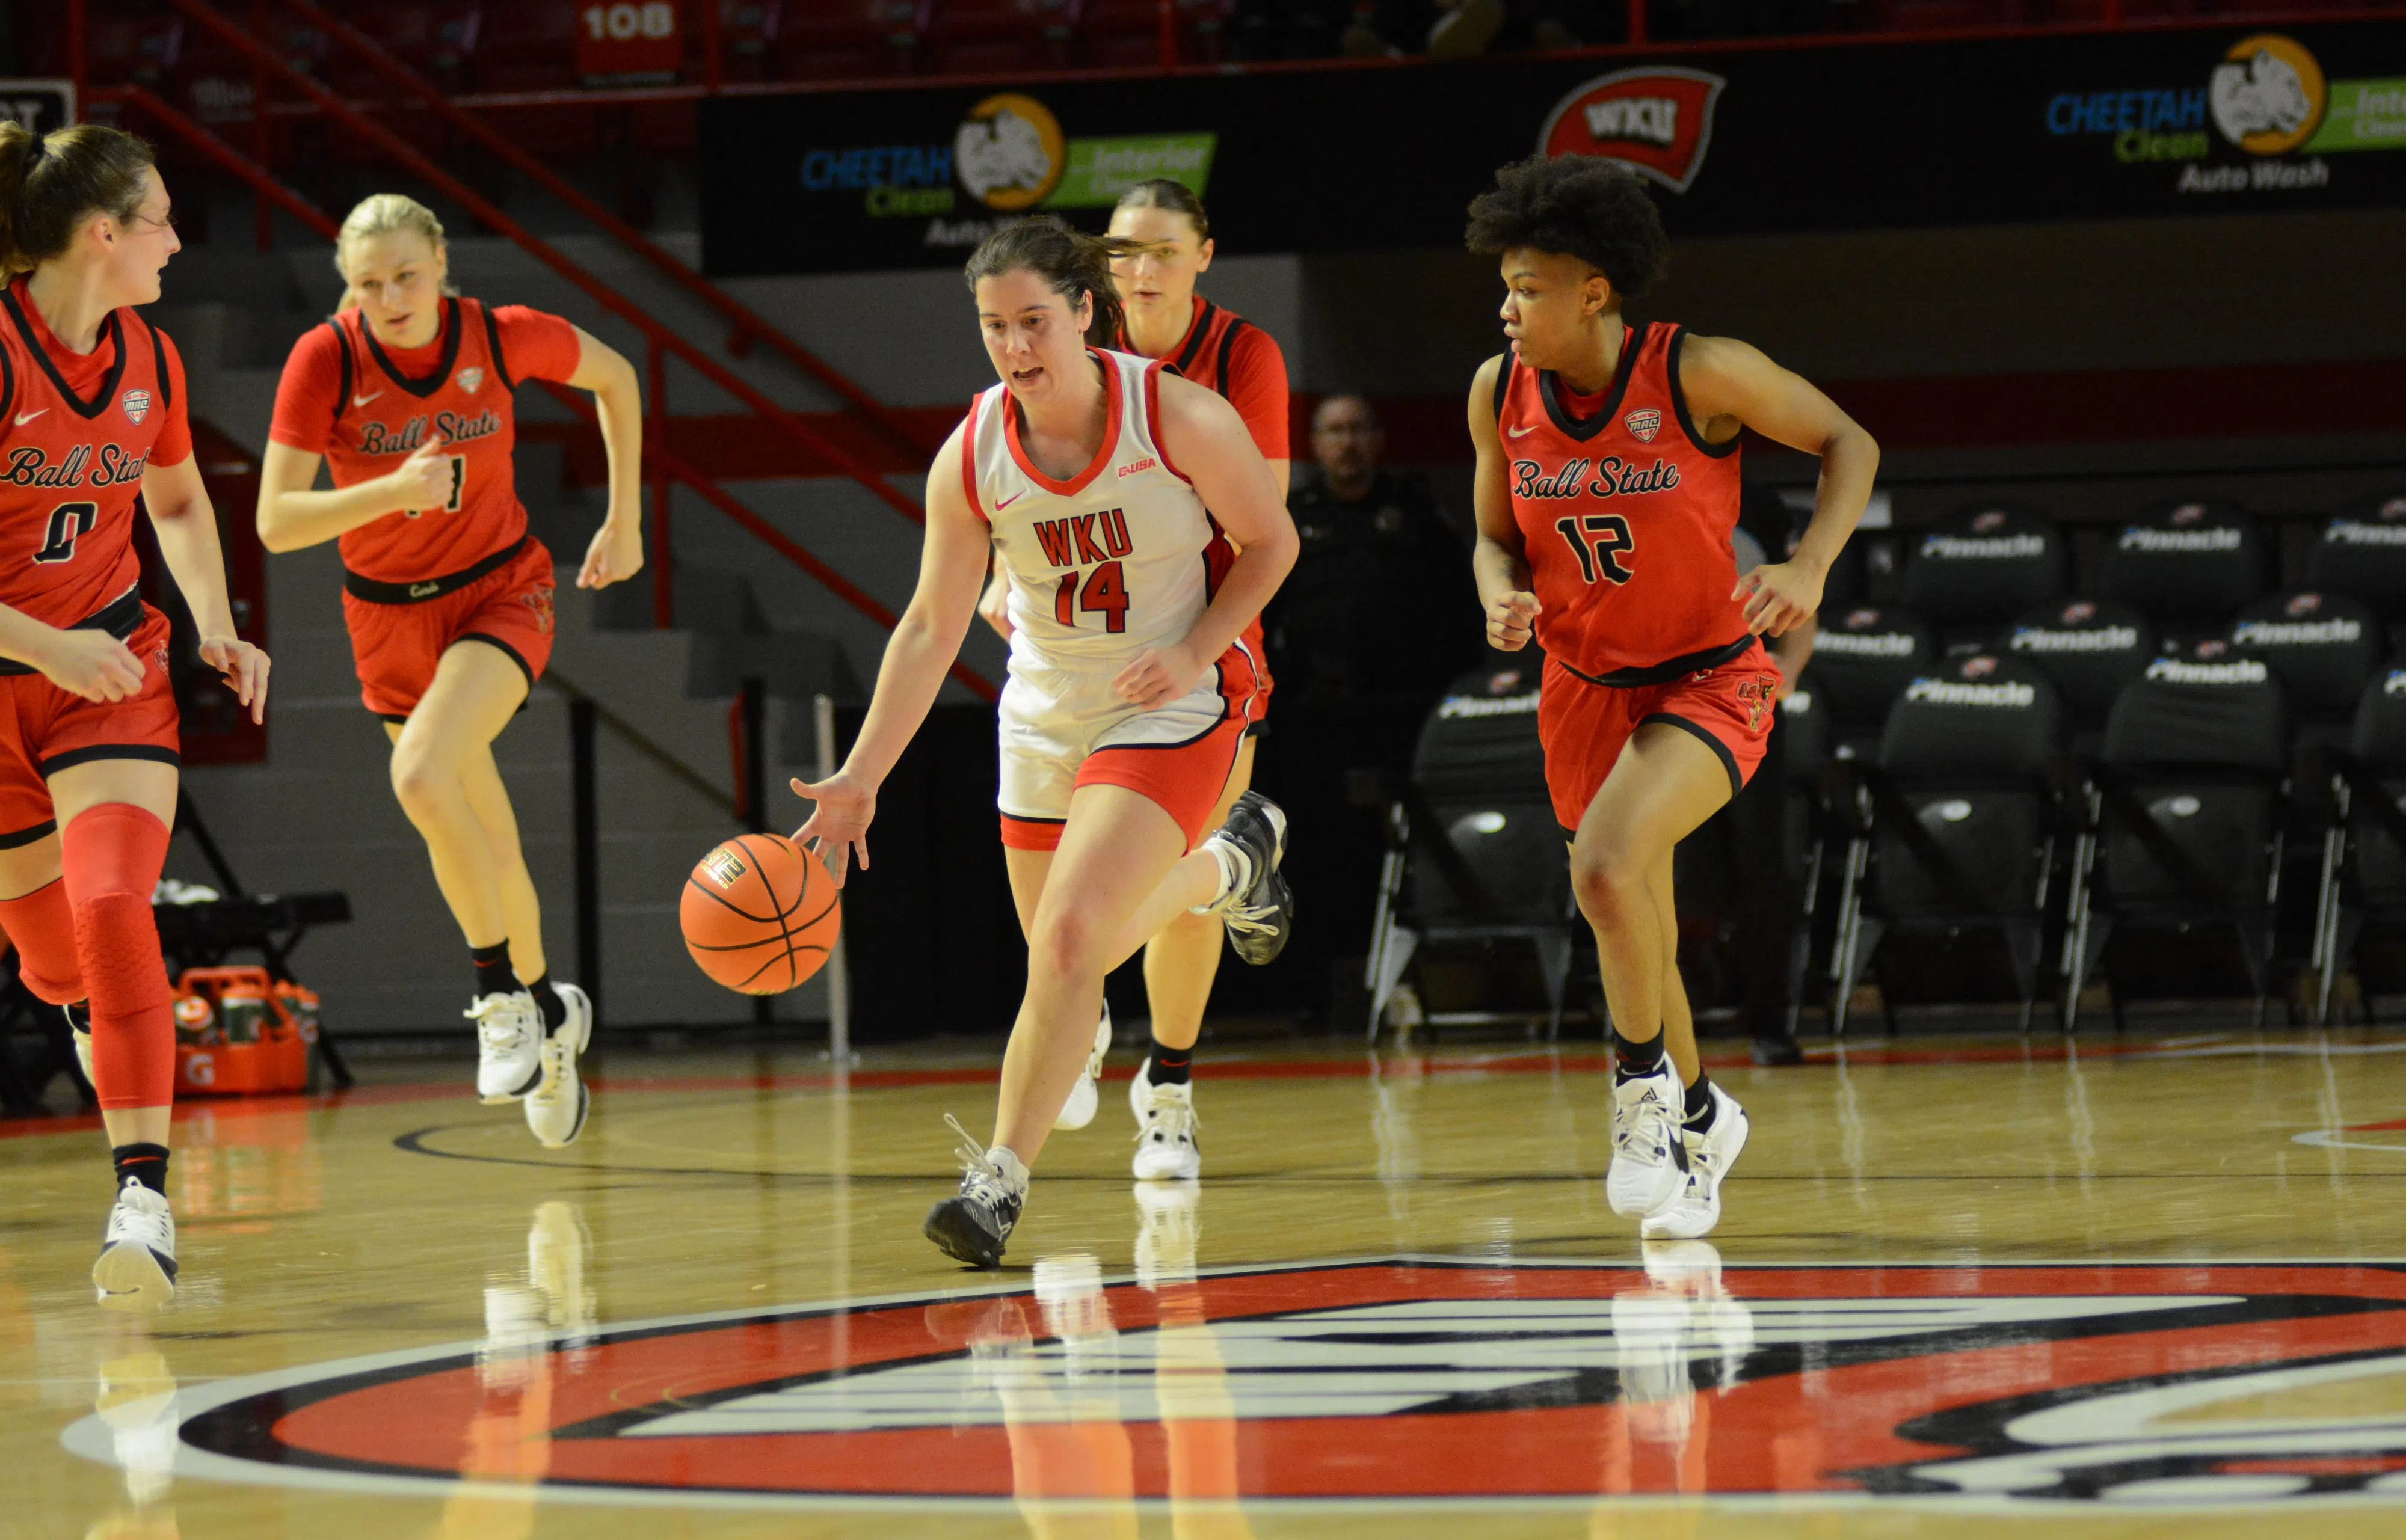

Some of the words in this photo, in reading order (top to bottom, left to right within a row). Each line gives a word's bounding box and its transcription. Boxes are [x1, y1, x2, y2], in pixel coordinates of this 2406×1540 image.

[584, 3, 674, 41] 108
[1583, 96, 1678, 144] WKU
[2047, 88, 2207, 135] CHEETAH
[802, 145, 952, 190] CHEETAH
[2177, 162, 2248, 193] Auto
[2250, 158, 2330, 188] Wash
[357, 414, 428, 455] Ball
[435, 408, 501, 447] State
[0, 444, 92, 488] Ball
[91, 443, 150, 488] Stat
[1513, 457, 1591, 500] Ball
[1589, 455, 1681, 499] State
[32, 501, 99, 565] 0
[1032, 508, 1133, 567] WKU
[1555, 514, 1635, 586] 12
[1054, 560, 1130, 634] 14
[1812, 630, 1915, 657] innacle
